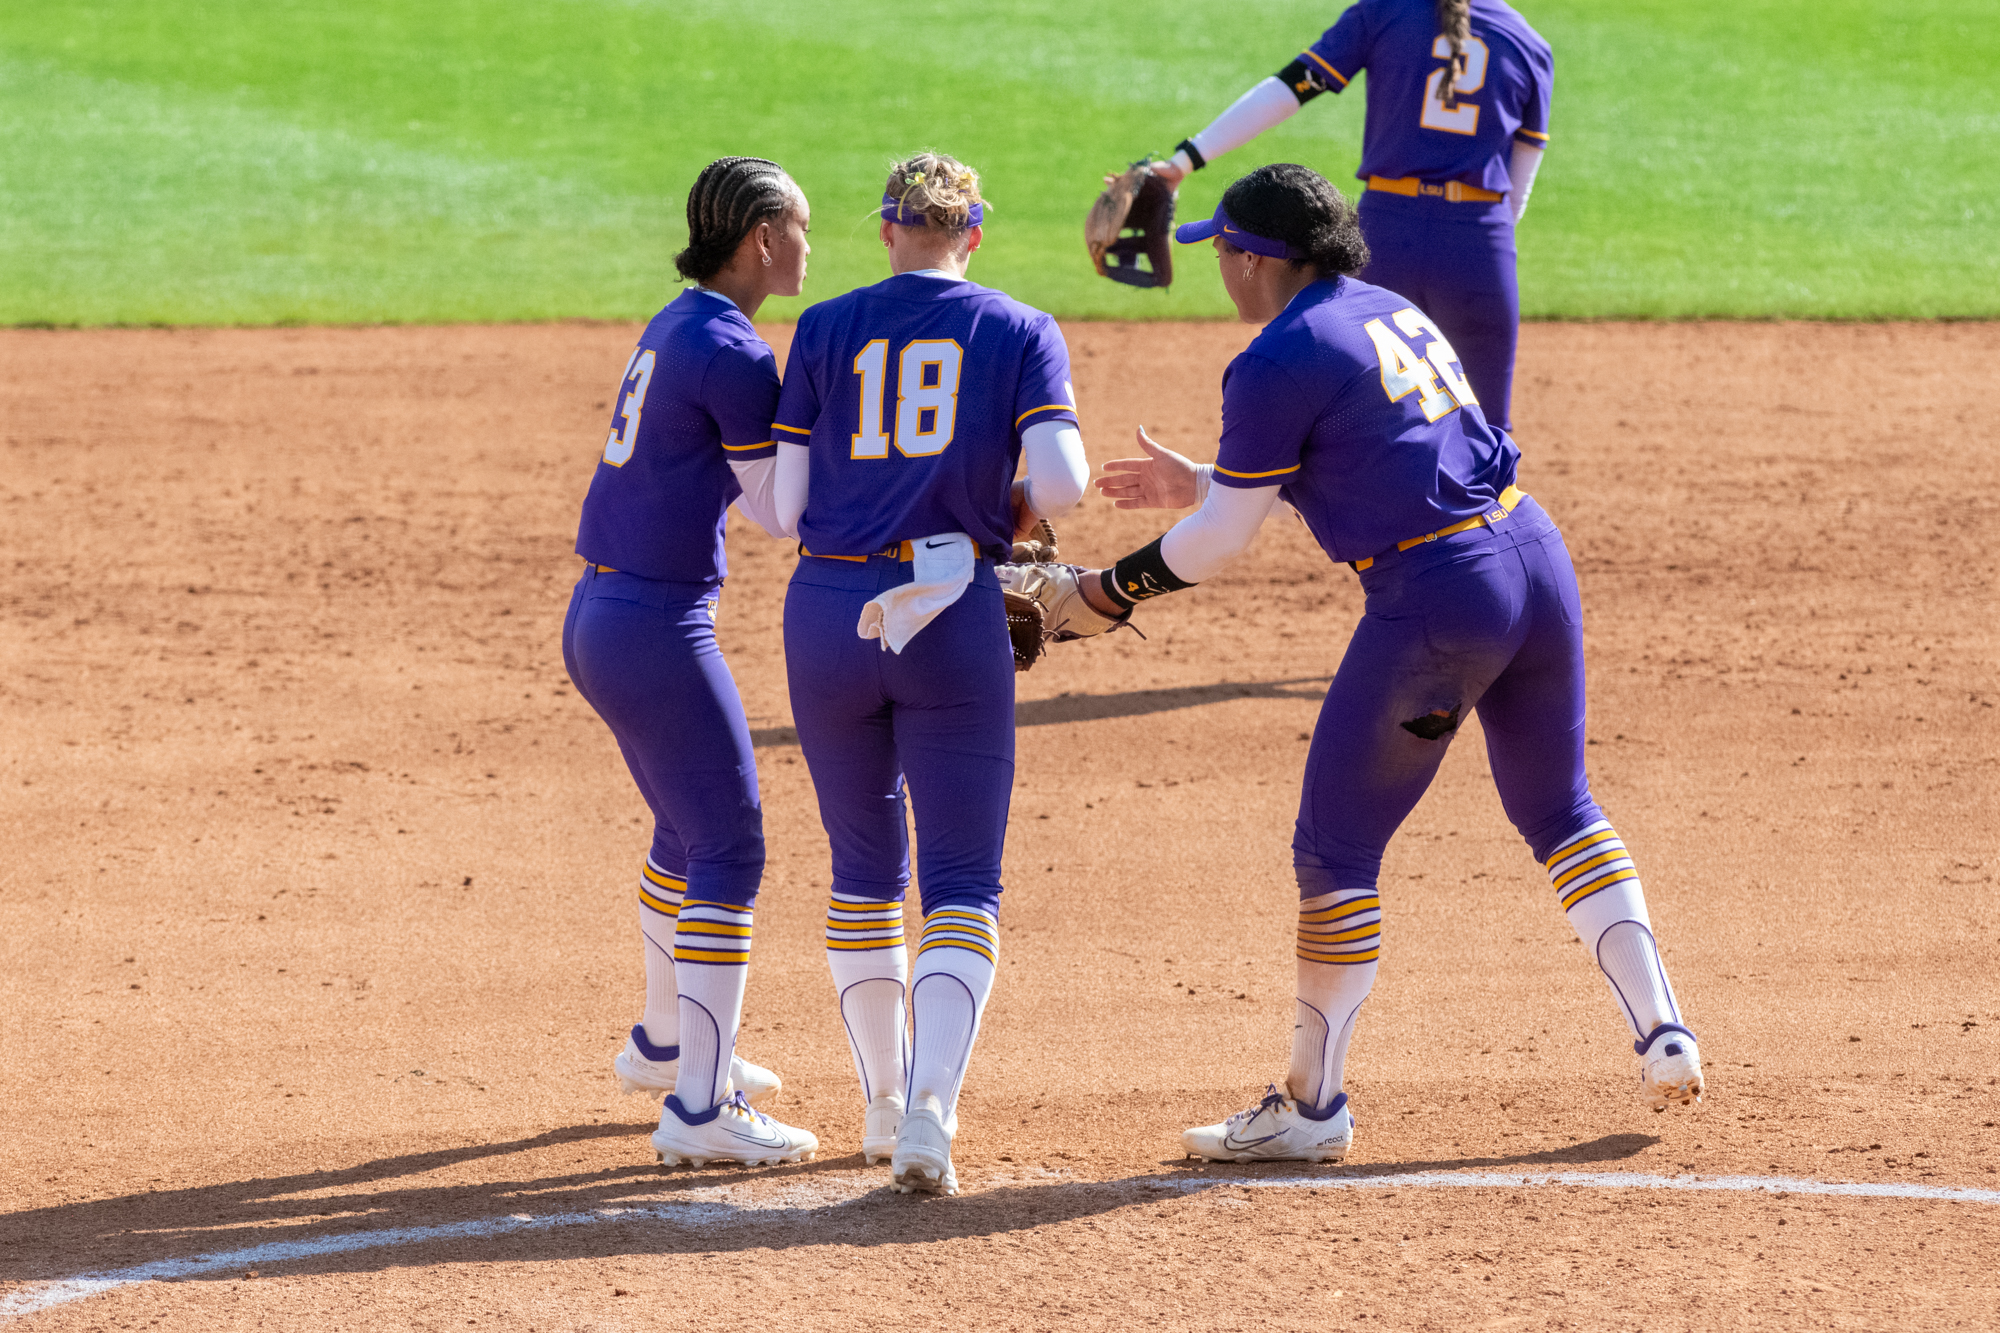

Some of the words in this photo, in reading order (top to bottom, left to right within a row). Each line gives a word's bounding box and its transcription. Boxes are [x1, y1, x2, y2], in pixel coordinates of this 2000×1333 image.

[1420, 34, 1490, 136] 2
[1420, 183, 1444, 197] LSU
[603, 346, 656, 468] 3
[850, 338, 964, 459] 18
[1363, 307, 1480, 423] 42
[1485, 508, 1509, 523] LSU
